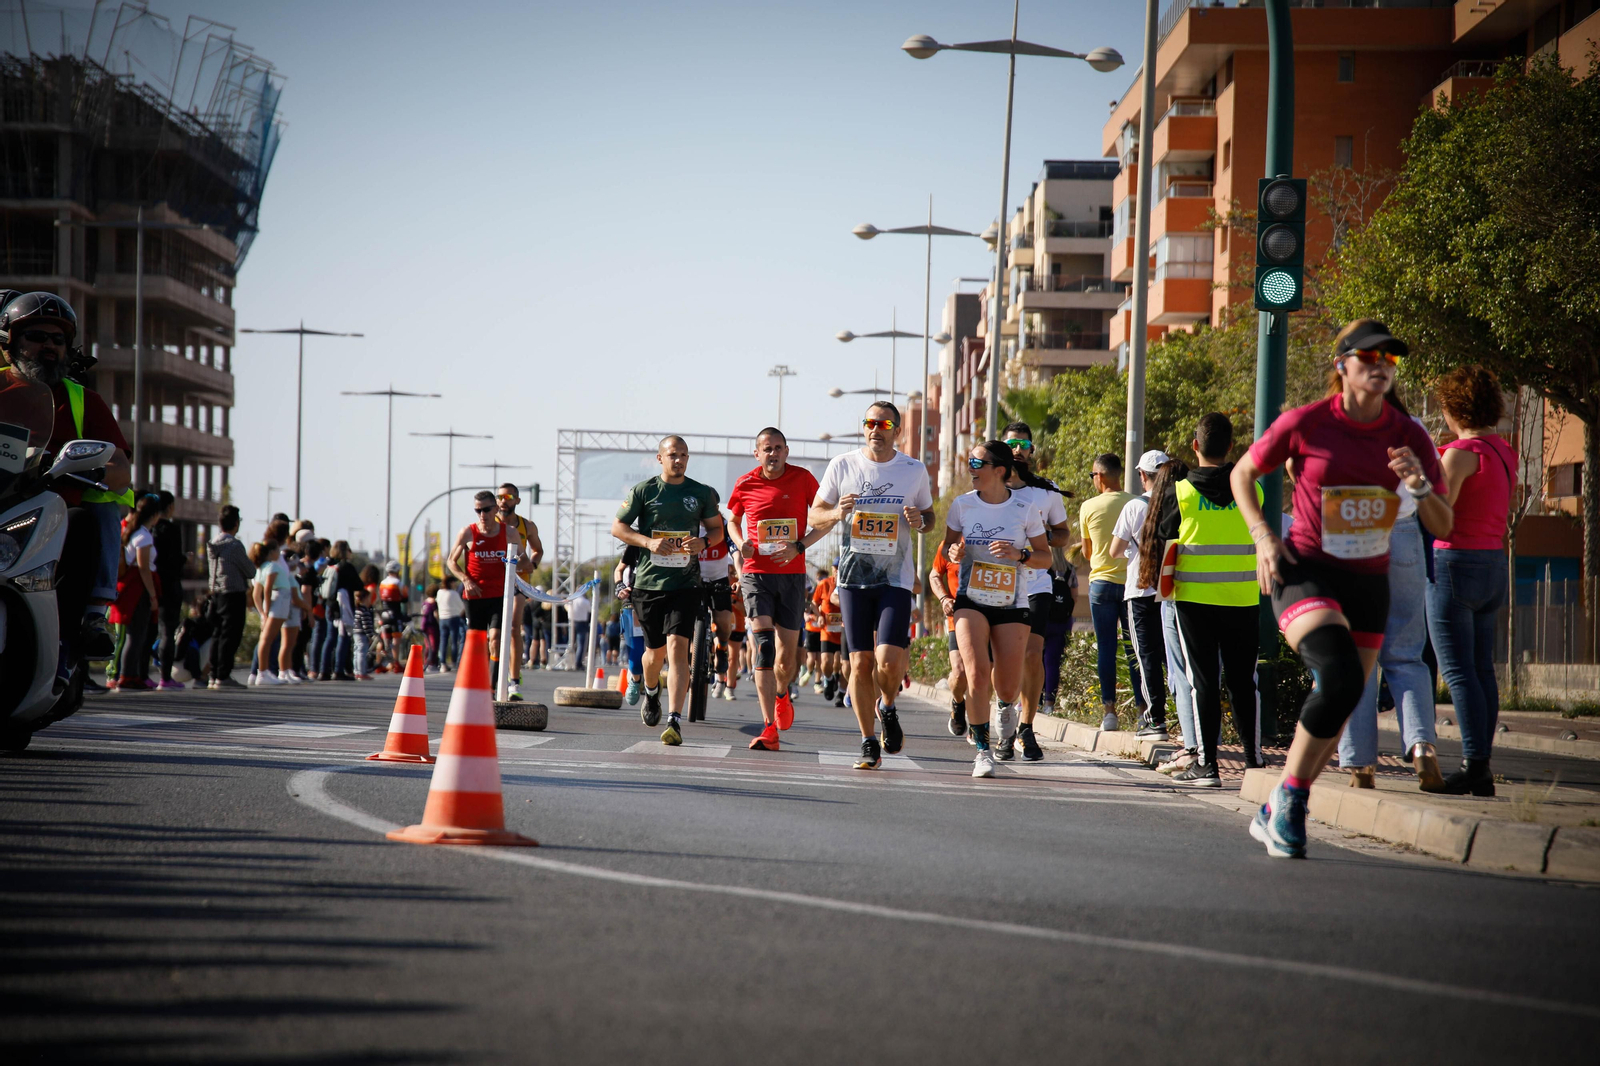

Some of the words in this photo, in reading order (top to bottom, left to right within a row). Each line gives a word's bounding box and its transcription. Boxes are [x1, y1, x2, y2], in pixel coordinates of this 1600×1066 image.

[1340, 498, 1386, 520] 689
[766, 525, 790, 536] 179
[857, 518, 894, 533] 1512
[976, 568, 1012, 586] 1513
